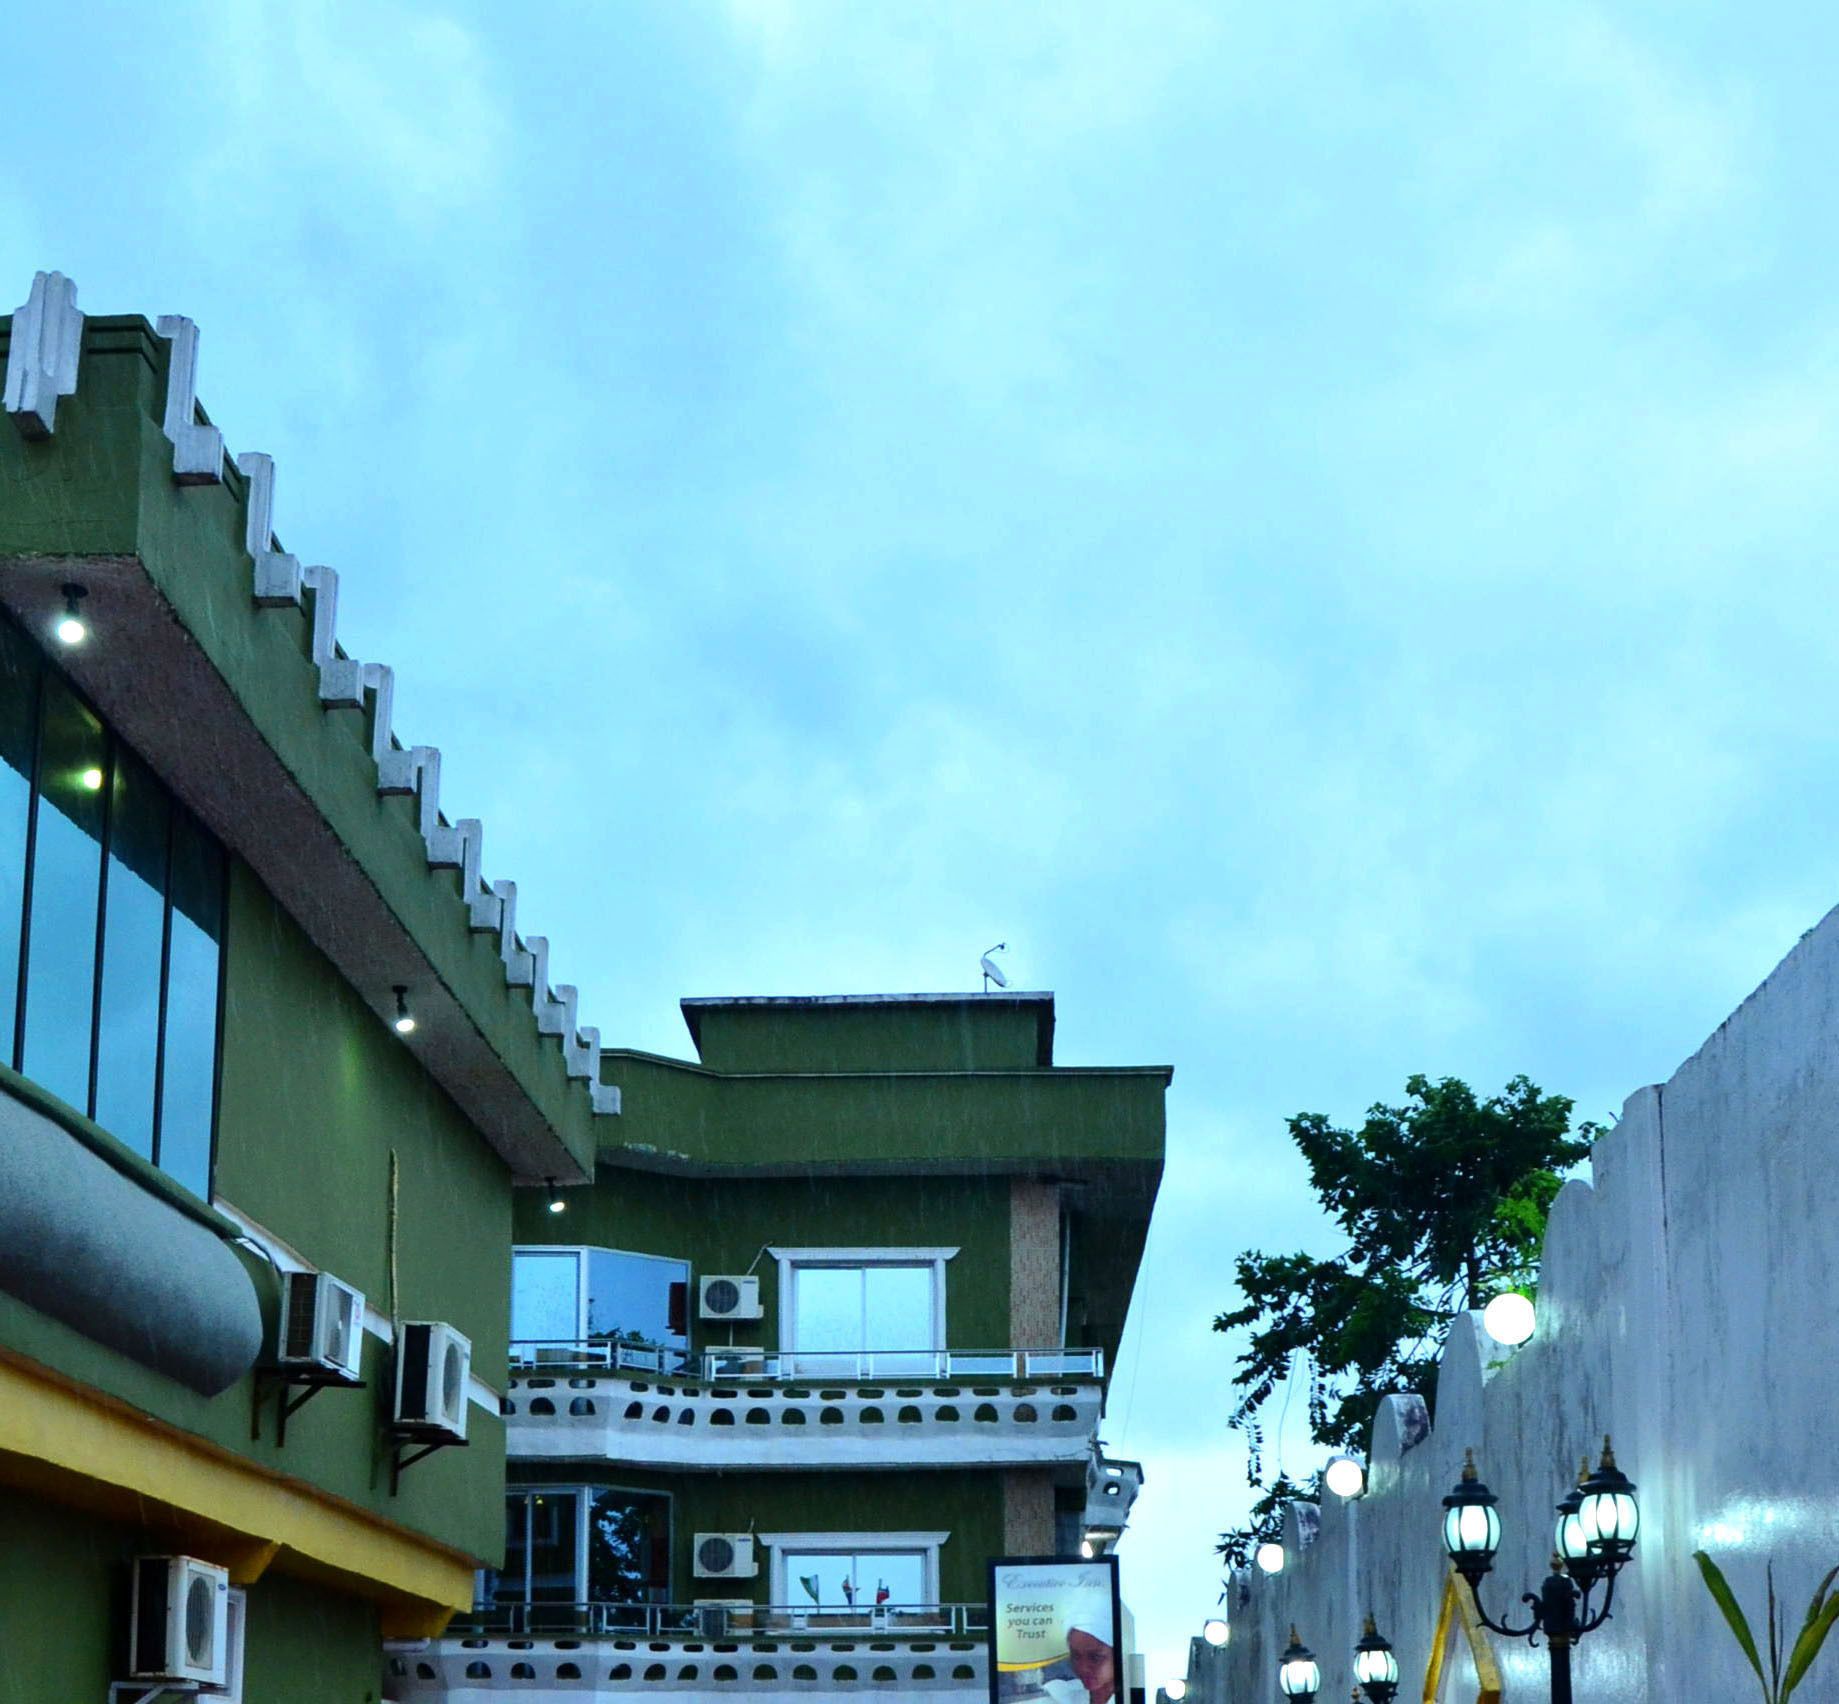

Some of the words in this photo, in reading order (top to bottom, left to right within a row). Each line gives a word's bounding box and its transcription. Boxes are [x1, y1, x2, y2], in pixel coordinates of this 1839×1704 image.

[1006, 1603, 1054, 1613] Services
[1008, 1618, 1030, 1628] you
[1033, 1617, 1053, 1626] can
[1017, 1630, 1046, 1639] Trust
